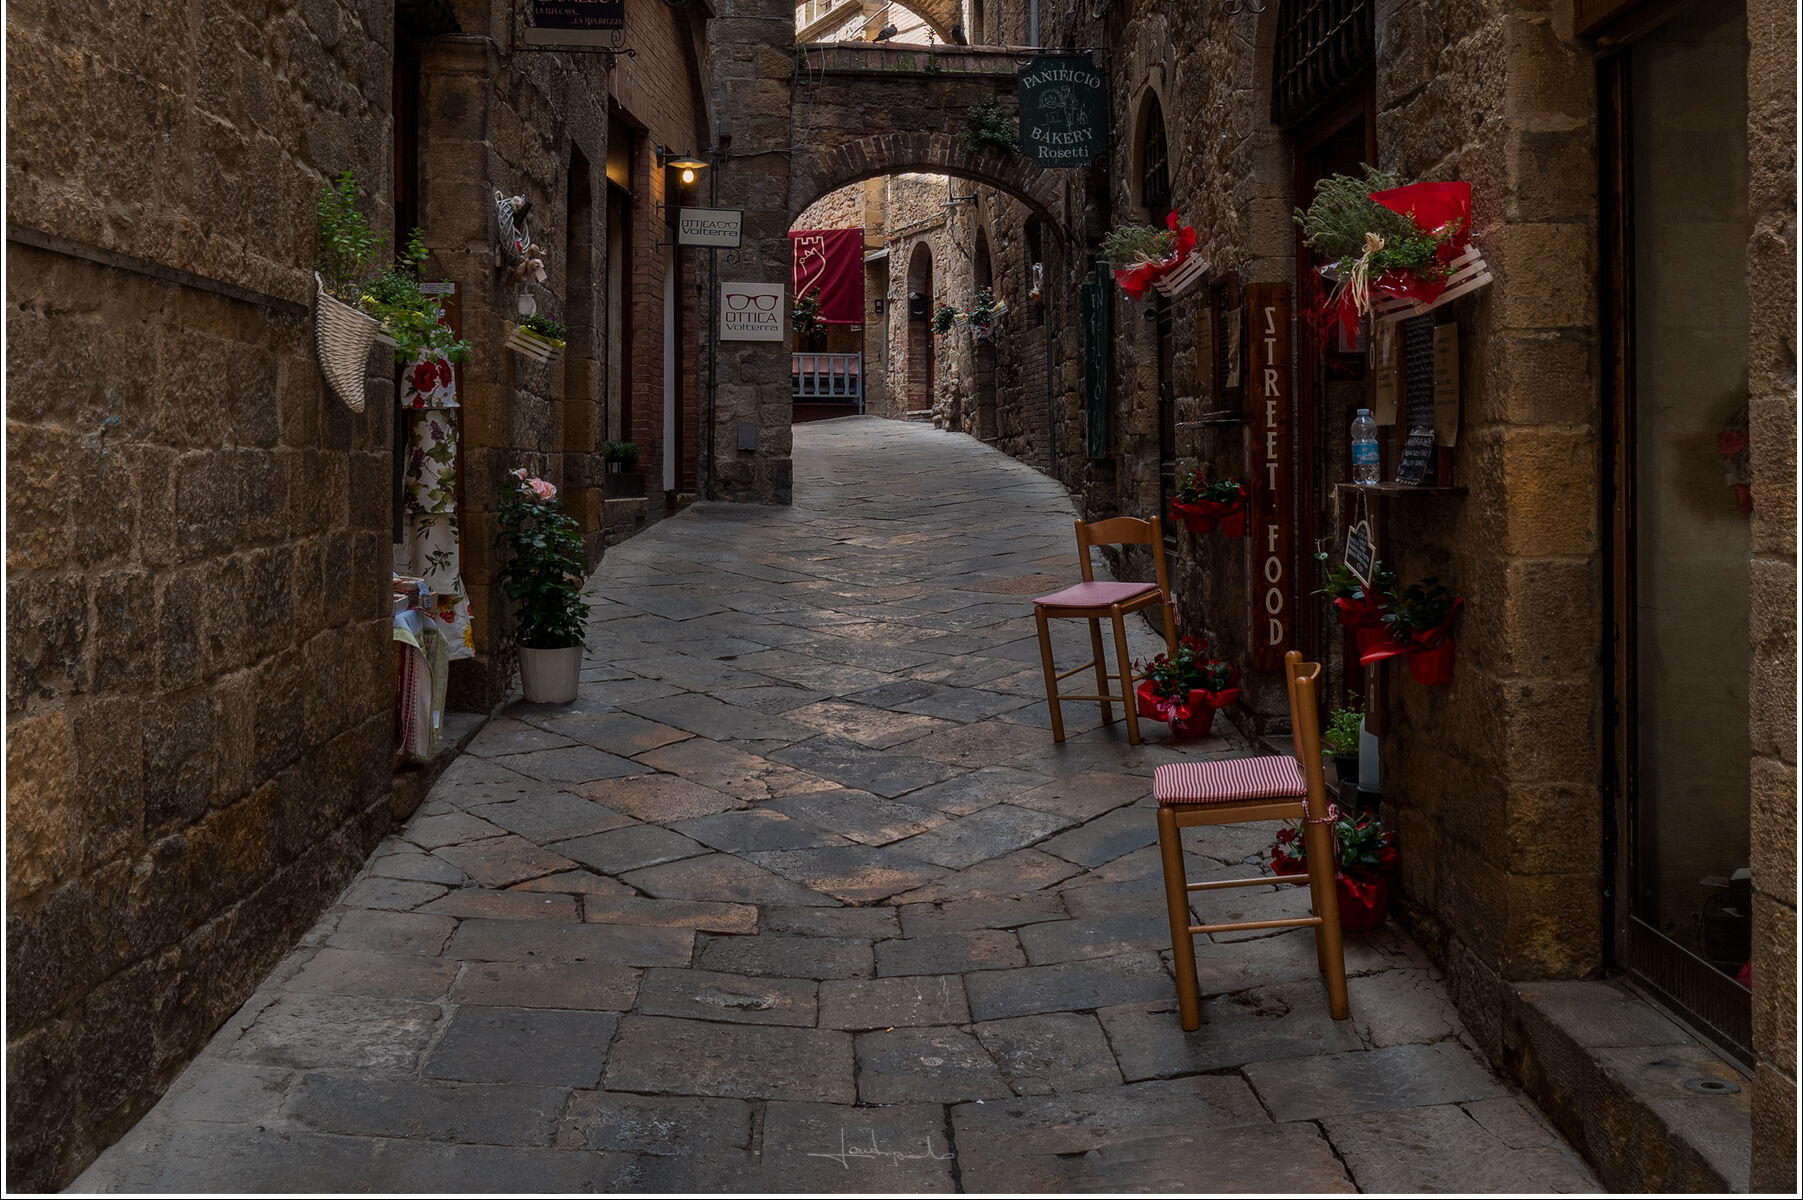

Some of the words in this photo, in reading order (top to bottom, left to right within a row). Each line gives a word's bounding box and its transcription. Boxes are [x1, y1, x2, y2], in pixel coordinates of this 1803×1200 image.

[1022, 69, 1101, 89] PANIFICIO
[1030, 126, 1094, 145] BAKERY
[1038, 145, 1089, 159] Rosetti
[681, 219, 717, 229] OTTICA
[681, 226, 738, 237] Volterra
[725, 312, 778, 324] OTTICA
[726, 323, 779, 331] Volterra
[1263, 305, 1282, 492] STREET
[1264, 524, 1284, 646] FOOD
